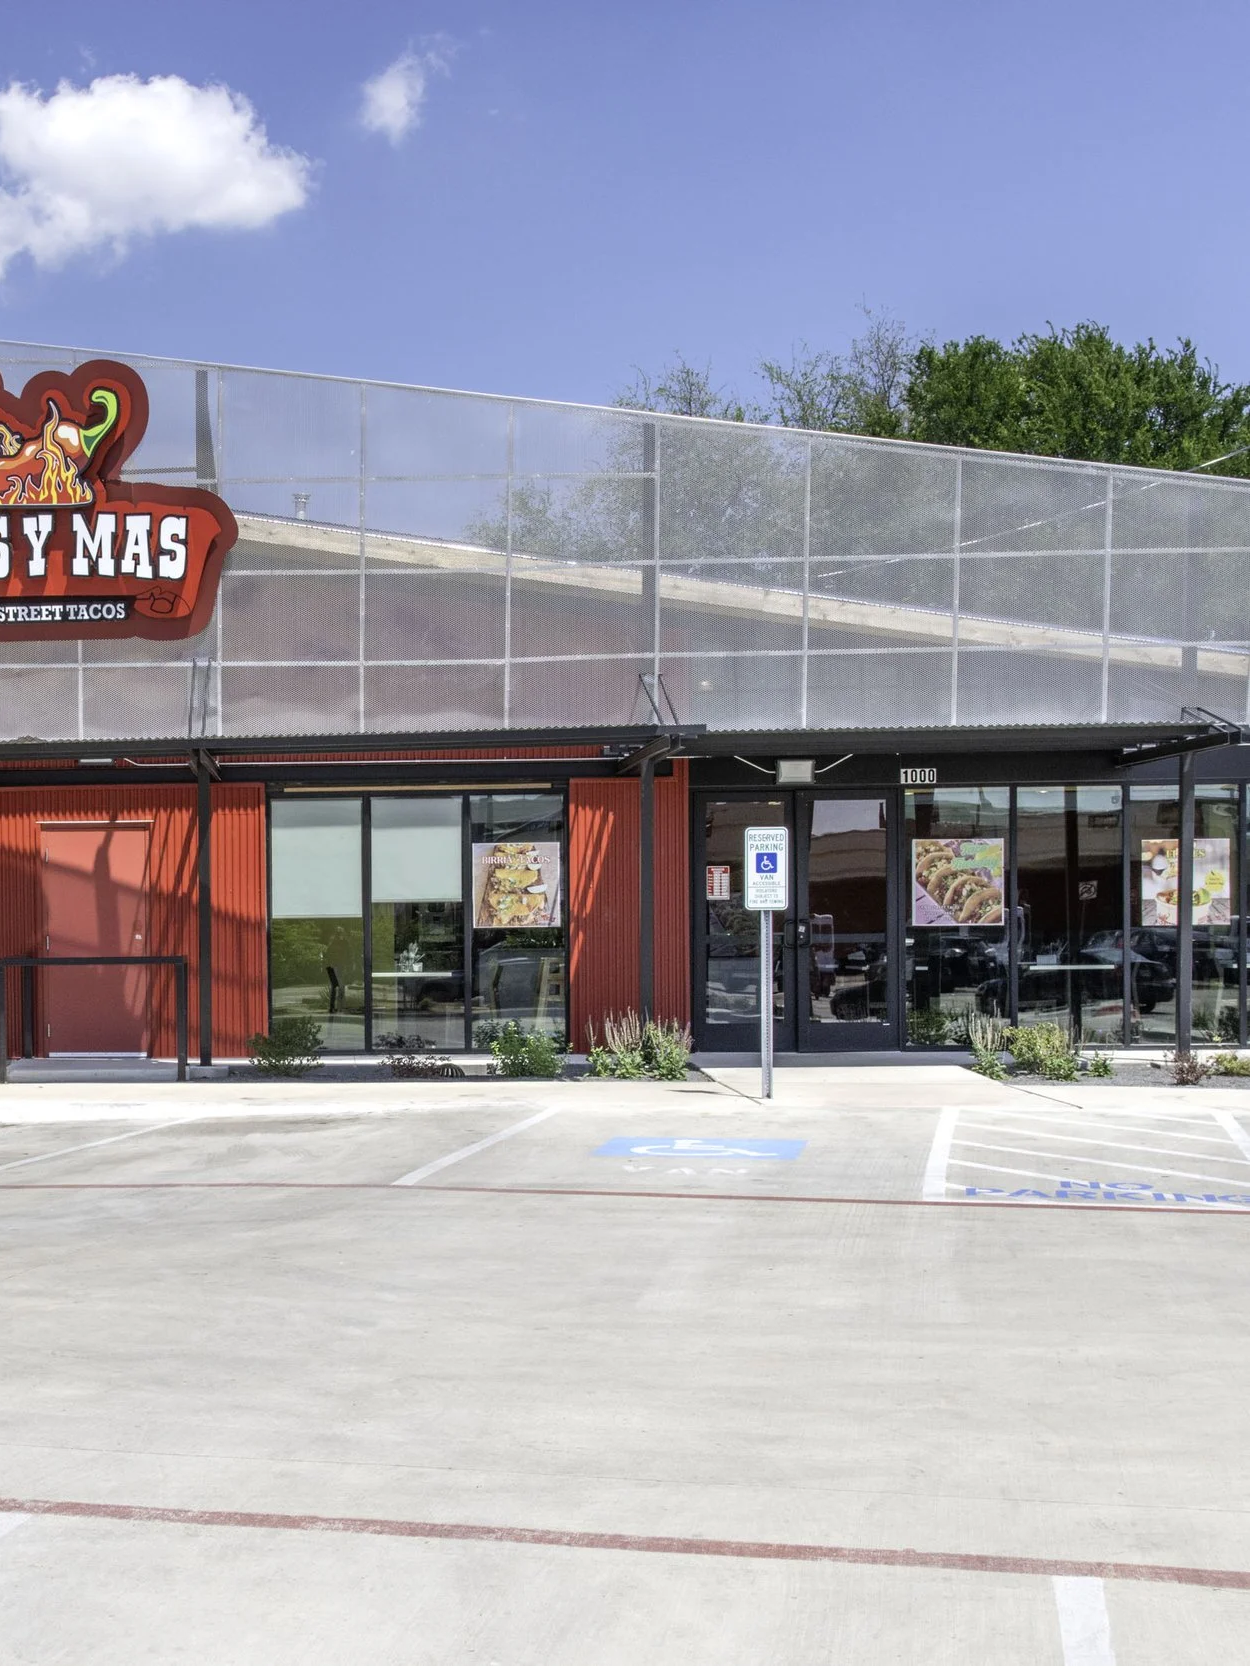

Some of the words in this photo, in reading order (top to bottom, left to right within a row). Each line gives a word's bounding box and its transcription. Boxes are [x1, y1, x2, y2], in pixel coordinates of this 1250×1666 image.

[22, 513, 55, 578] Y
[72, 512, 189, 580] MAS
[66, 603, 126, 620] TACOS
[902, 769, 935, 783] 1000
[749, 833, 784, 842] RESERVED
[750, 843, 784, 852] PARKING
[481, 855, 513, 864] BIRRIA
[518, 855, 552, 864] TACOS
[1060, 1181, 1153, 1191] NO
